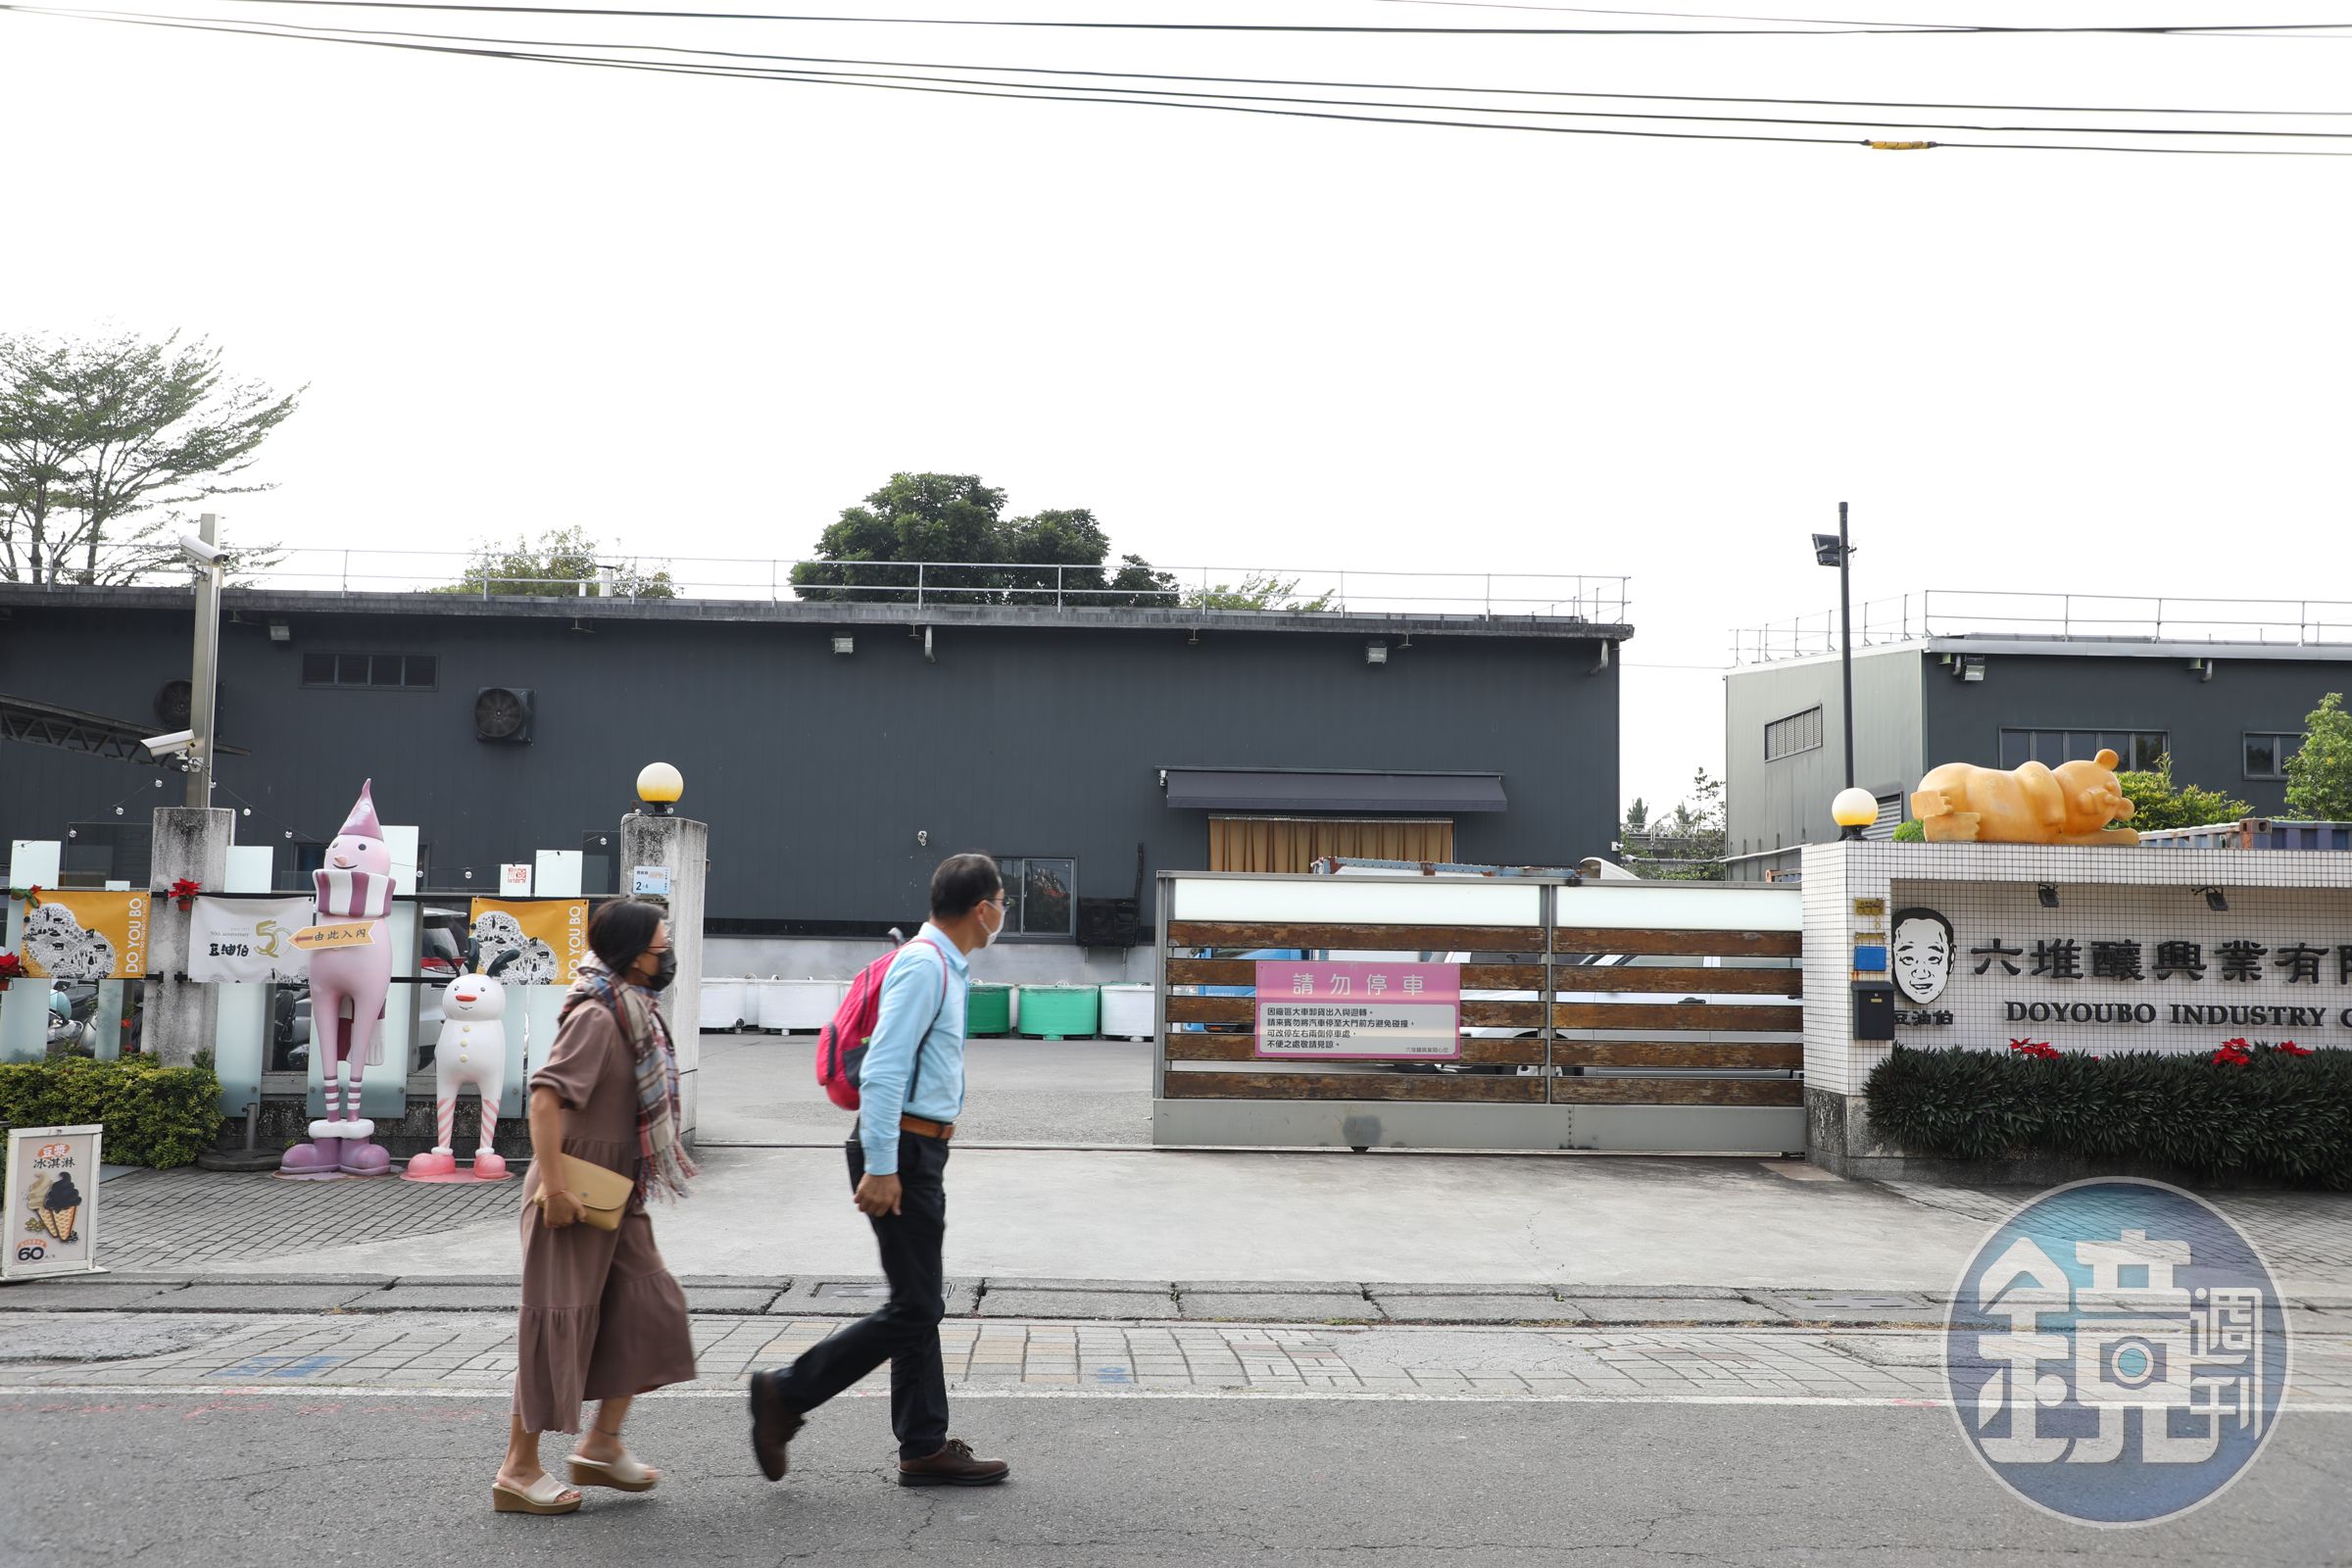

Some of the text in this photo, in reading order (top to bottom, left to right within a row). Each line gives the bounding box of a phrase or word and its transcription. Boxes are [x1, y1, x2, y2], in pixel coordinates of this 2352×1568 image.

[125, 898, 142, 972] DO YOU BO
[567, 906, 580, 980] DO YOU BO
[209, 943, 249, 956] 豆油伯
[1970, 938, 2352, 986] 六堆釀興業有
[1293, 972, 1424, 996] 請勿停車
[1893, 1010, 1954, 1027] 豆油伯
[2005, 1001, 2156, 1023] DOYOUBO
[2170, 1004, 2327, 1027] INDUSTRY
[43, 1144, 68, 1156] 豆漿
[33, 1157, 75, 1169] 冰淇淋
[18, 1246, 44, 1261] 60
